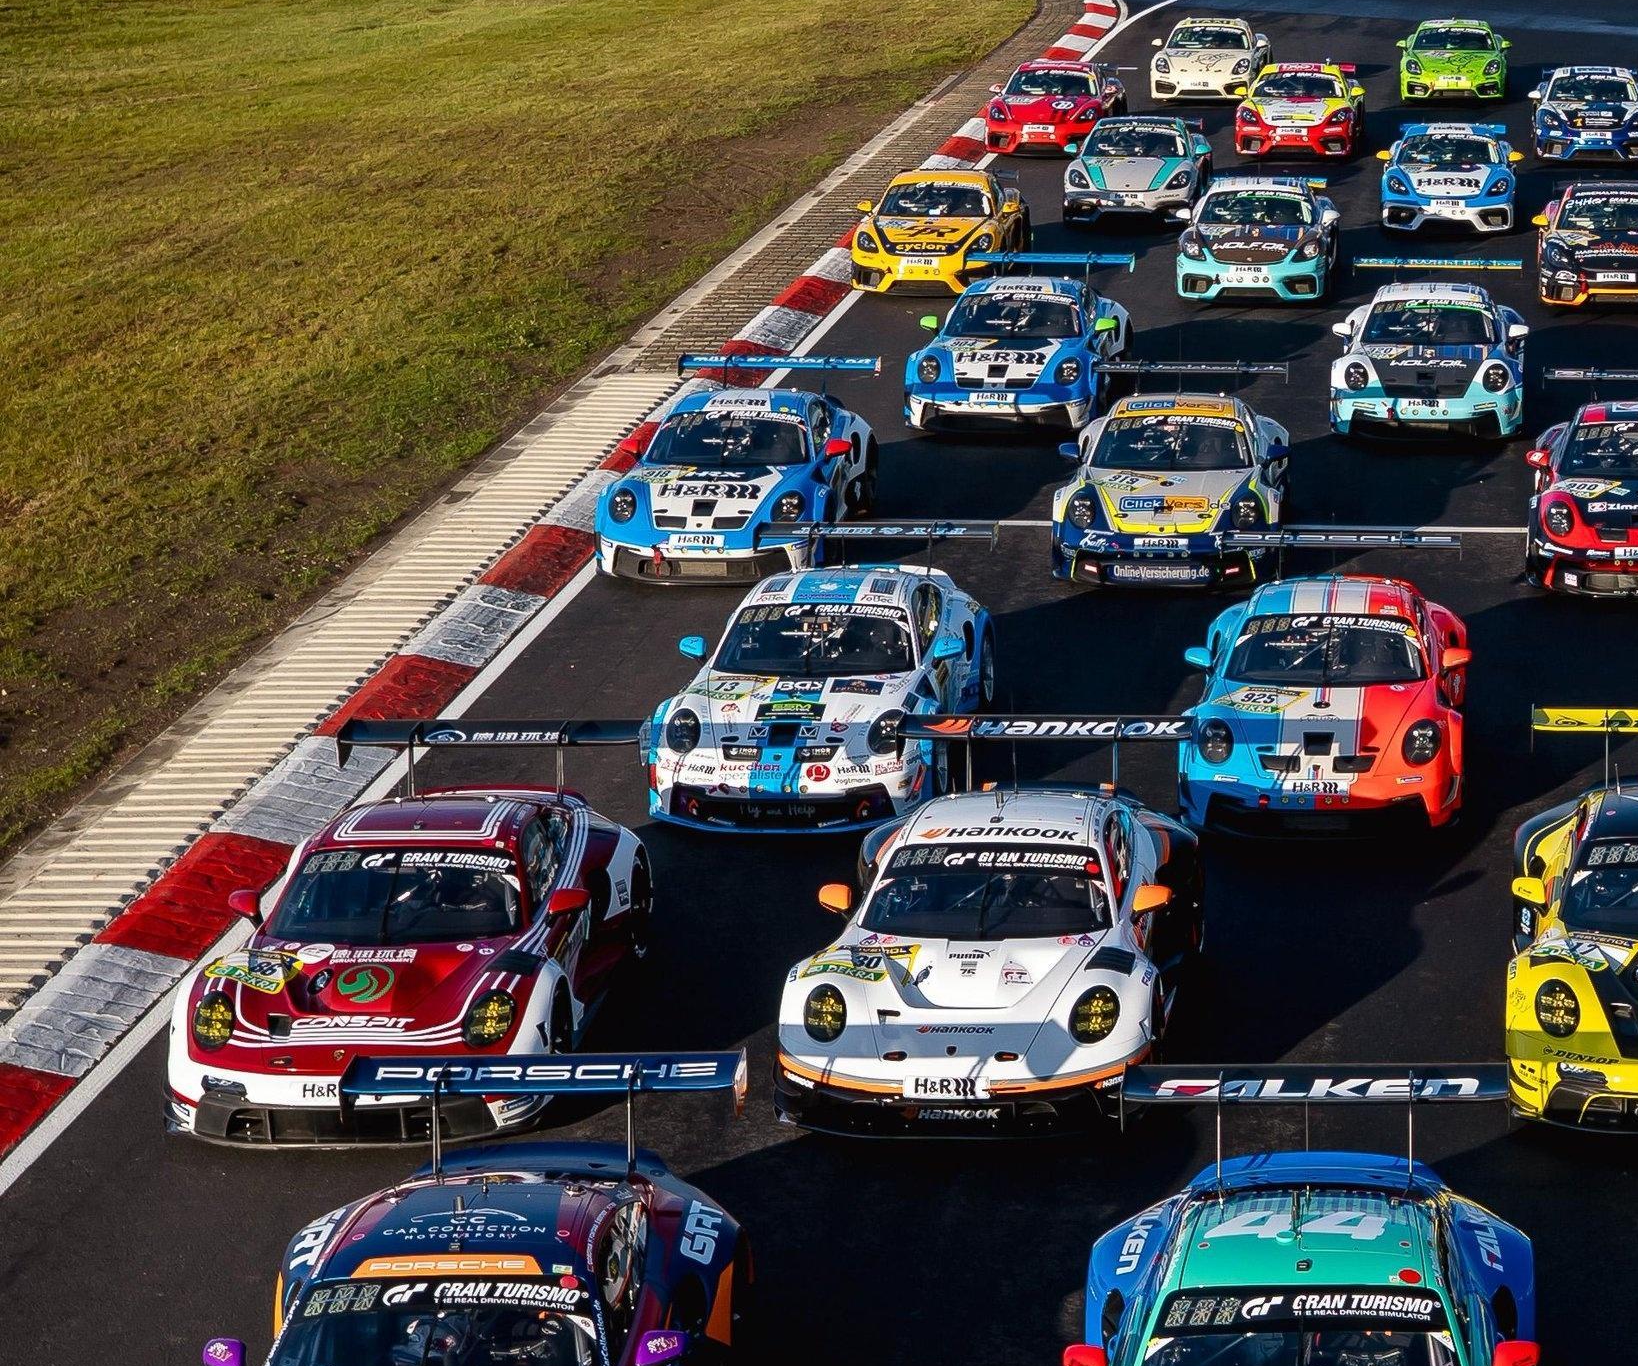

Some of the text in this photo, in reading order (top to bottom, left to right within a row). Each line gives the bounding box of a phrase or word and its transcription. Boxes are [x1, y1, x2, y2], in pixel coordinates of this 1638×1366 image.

[956, 351, 1011, 364] H&R
[976, 393, 997, 401] H&R
[1167, 415, 1236, 429] GRAN TURISMO
[660, 483, 723, 498] H&R
[677, 536, 701, 544] H&R
[850, 605, 903, 619] TURISMO
[1322, 616, 1408, 633] GRAN TURISMO
[1240, 691, 1277, 705] 925
[838, 765, 859, 775] H&R
[1293, 781, 1320, 792] H&R
[401, 852, 511, 870] GRAN TURISMO
[1023, 853, 1088, 867] TURISMO
[234, 968, 280, 992] DEKRA
[827, 963, 876, 982] DEKRA
[291, 1015, 416, 1031] CONSPIT
[1551, 1047, 1621, 1066] DUNLOP
[374, 1062, 719, 1083] PORSCHE
[302, 1082, 337, 1099] H&R
[913, 1076, 952, 1095] H&R
[1154, 1077, 1482, 1099] FALKEN
[383, 1225, 548, 1236] CAR COLLECTION
[1203, 1210, 1387, 1241] 44
[368, 1260, 527, 1273] PORSCHE
[434, 1281, 496, 1298] GRAN
[498, 1282, 582, 1304] TURISMO
[480, 1297, 519, 1305] DRIVING
[520, 1299, 576, 1312] SIMULATOR
[1292, 1294, 1348, 1311] GRAN
[1350, 1295, 1434, 1314] TURISMO
[1339, 1310, 1378, 1318] DRIVING
[1380, 1311, 1431, 1321] SIMULATOR
